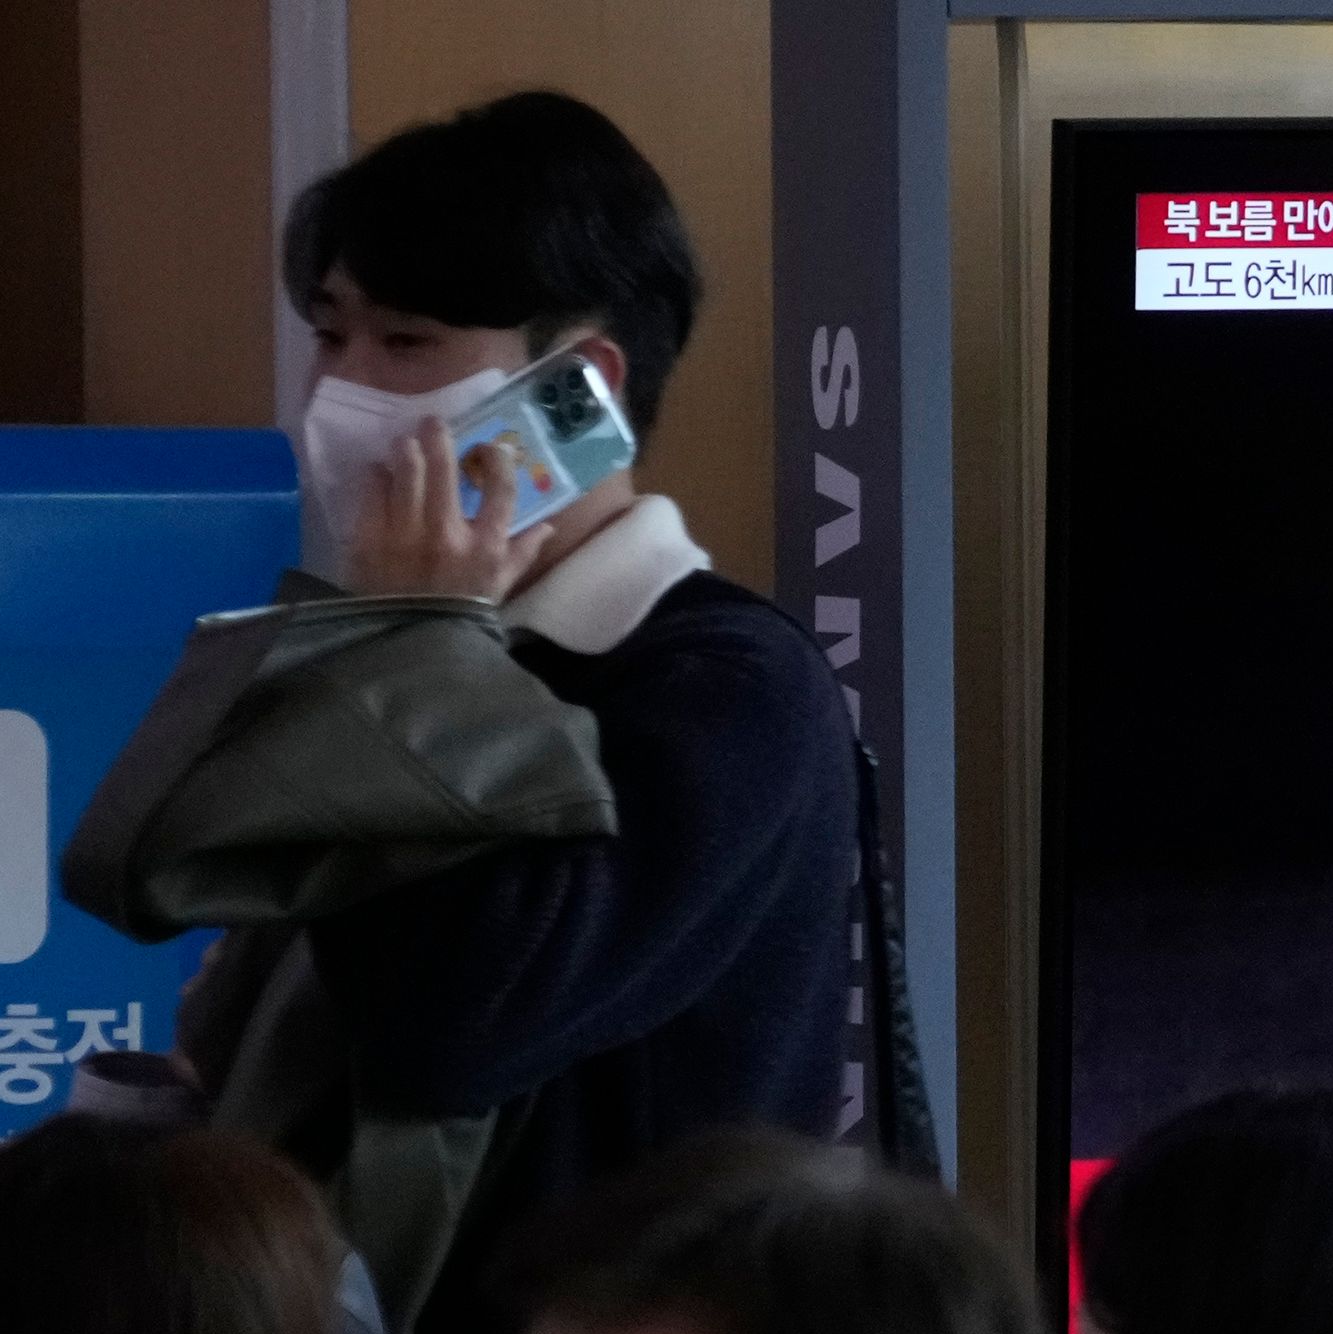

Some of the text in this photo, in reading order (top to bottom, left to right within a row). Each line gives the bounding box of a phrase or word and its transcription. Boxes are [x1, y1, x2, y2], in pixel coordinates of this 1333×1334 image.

[1163, 199, 1201, 242] 북
[1204, 199, 1277, 242] 보름
[1162, 260, 1237, 299] 고도
